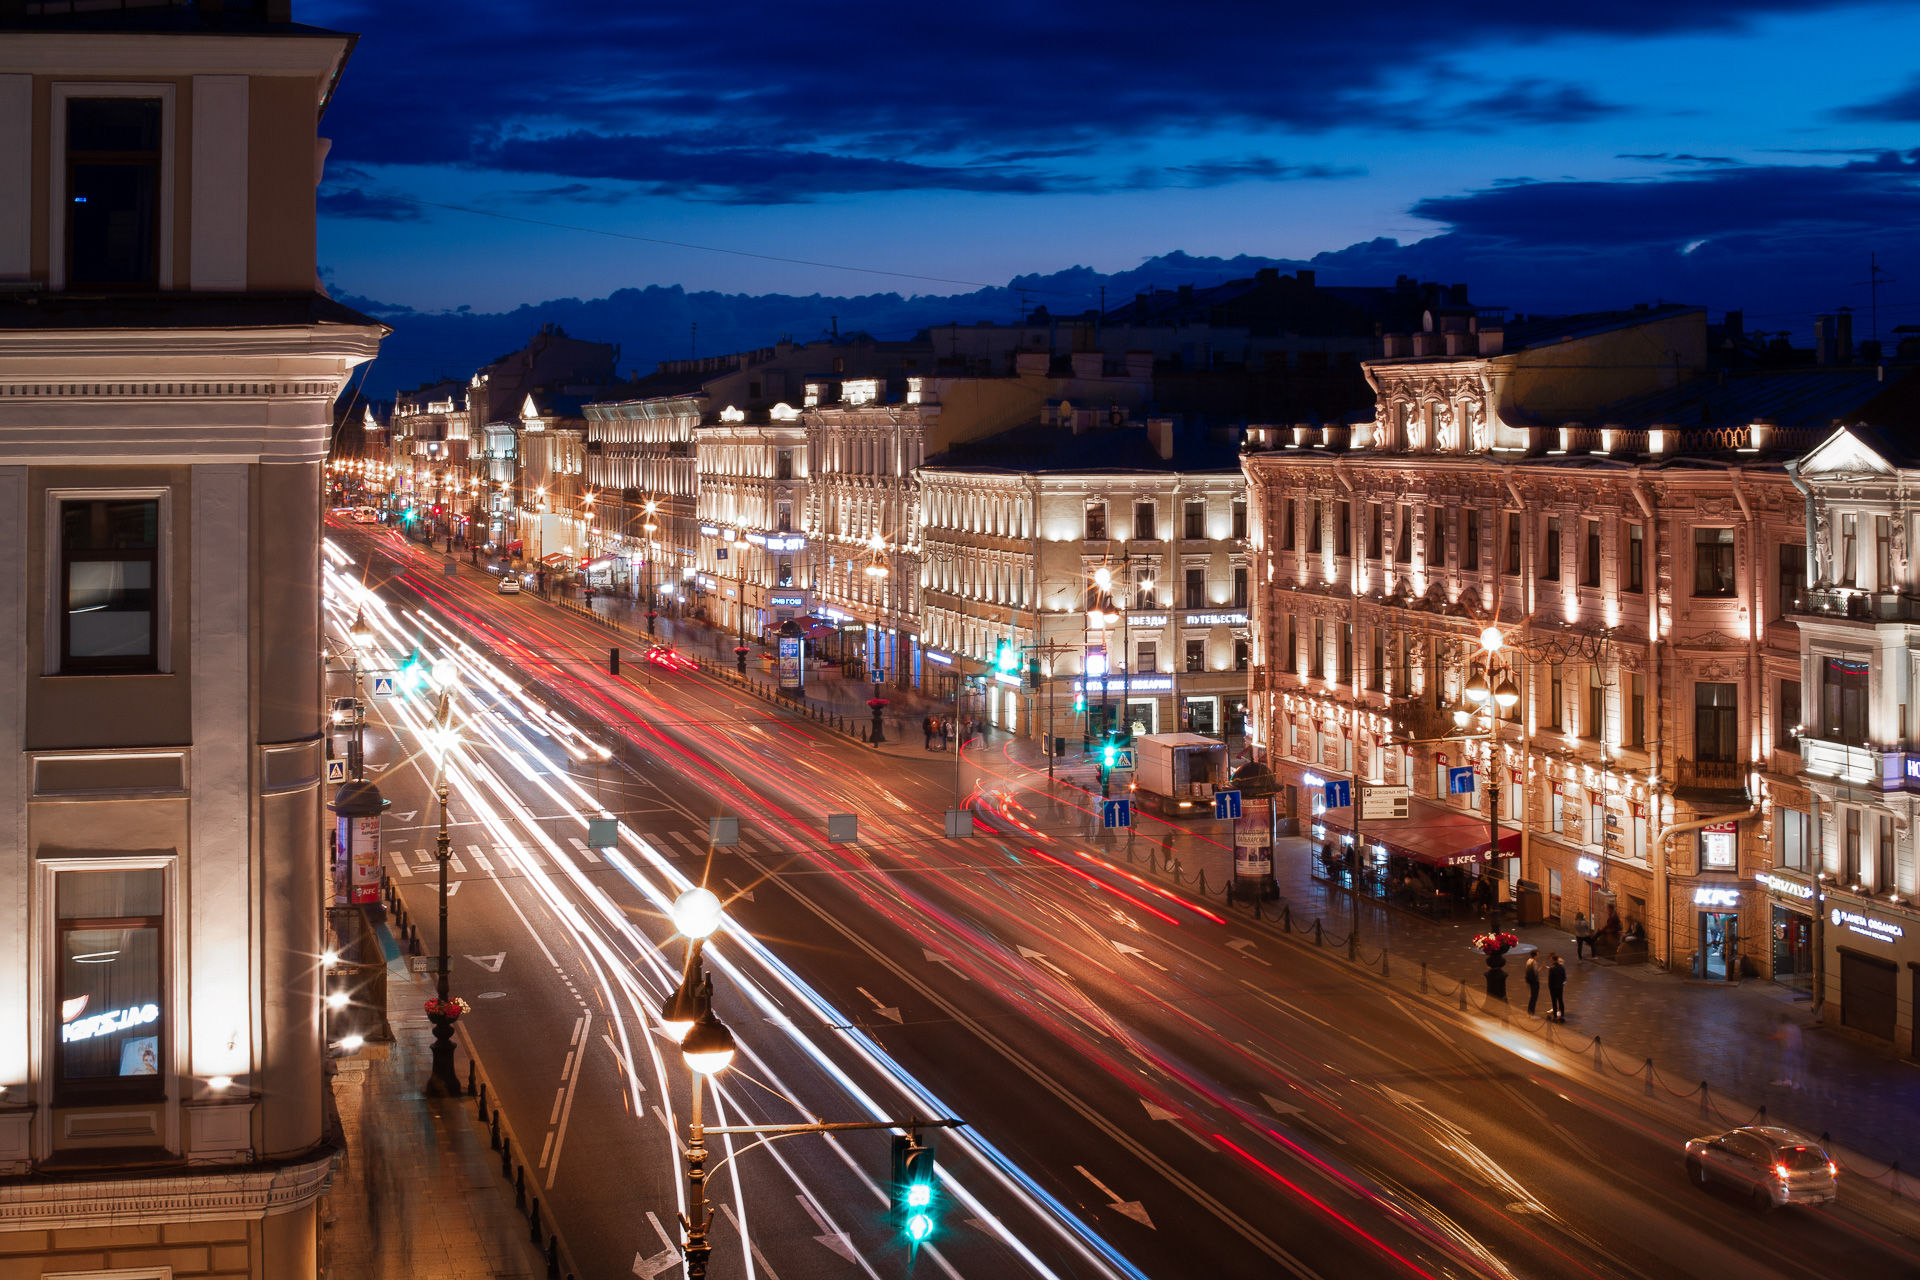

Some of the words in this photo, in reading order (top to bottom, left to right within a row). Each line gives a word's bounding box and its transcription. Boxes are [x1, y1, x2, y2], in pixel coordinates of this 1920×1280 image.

[1127, 615, 1167, 627] ЗВЕЗДЫ
[1456, 854, 1476, 865] KFC
[1578, 857, 1599, 877] KFC
[1694, 888, 1739, 906] KFC
[1841, 911, 1867, 927] PLANETA
[1868, 918, 1903, 937] ORGANICA
